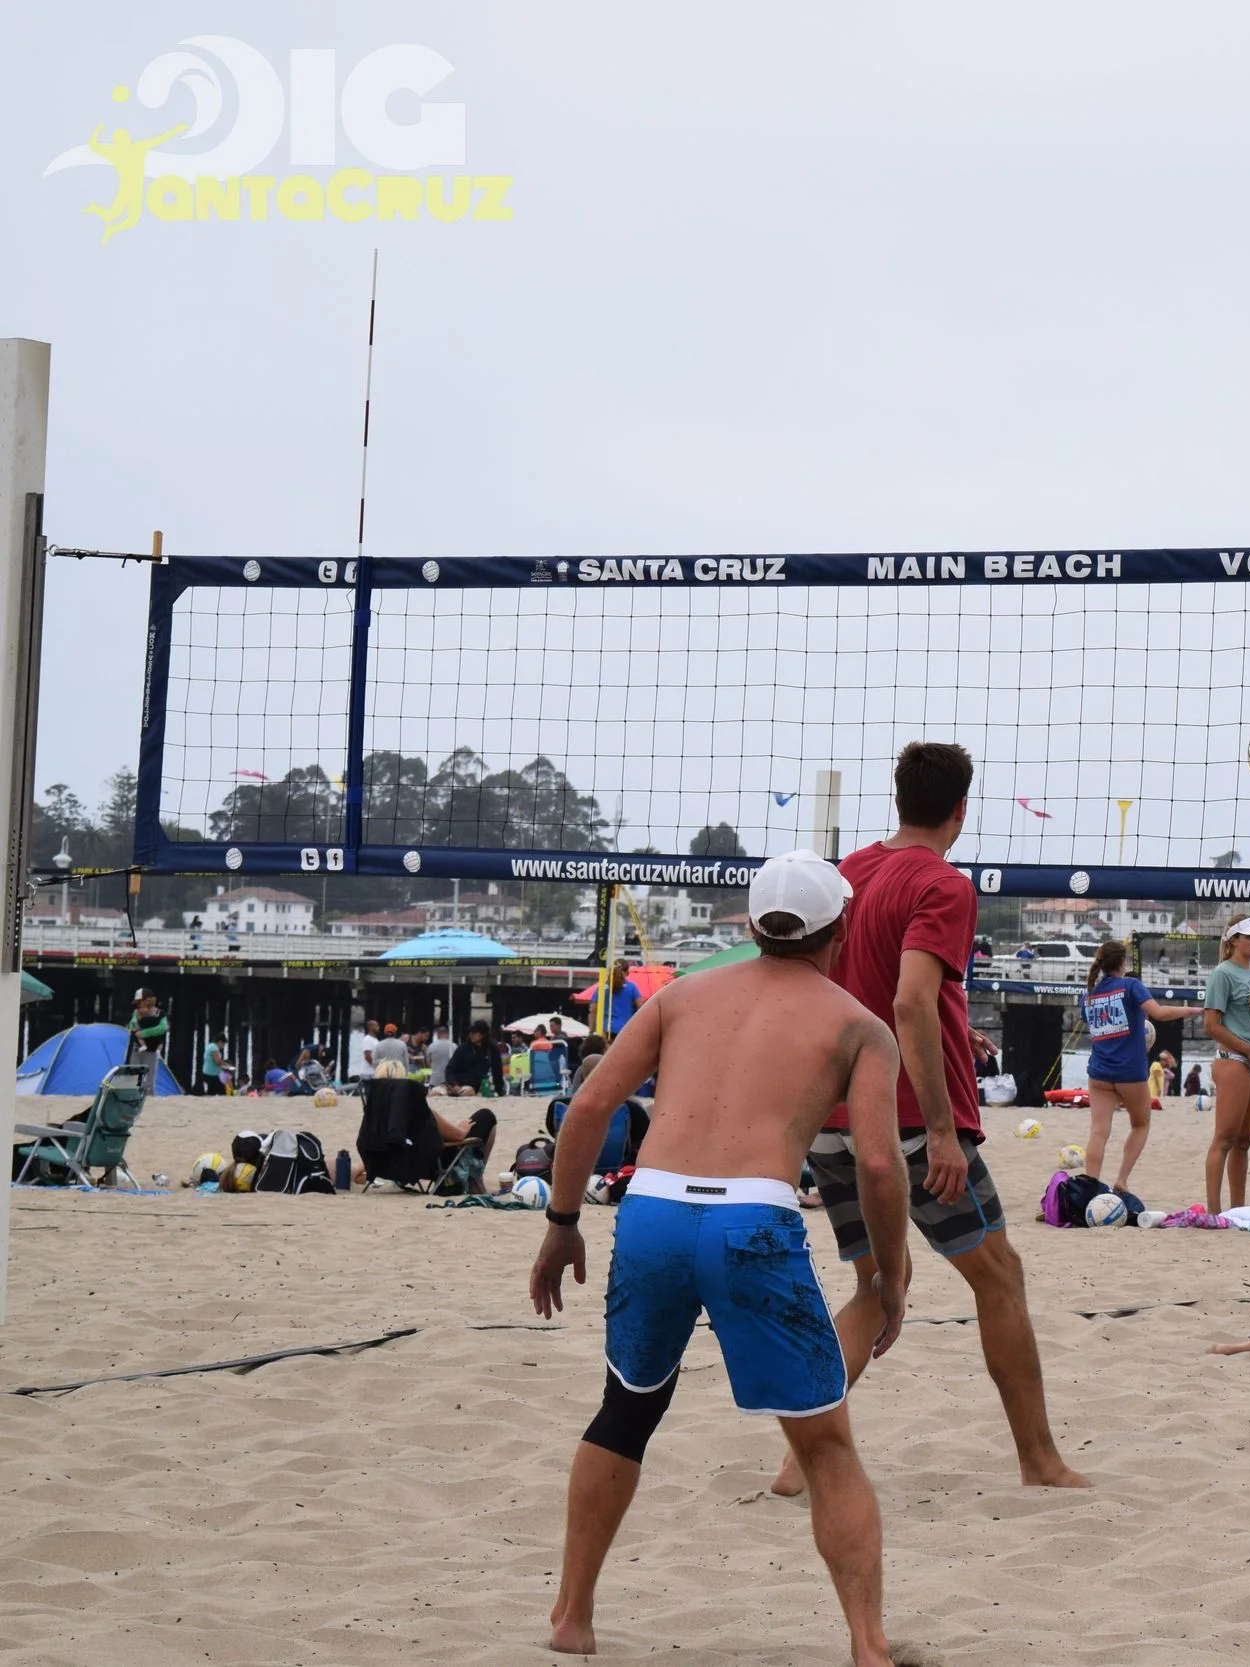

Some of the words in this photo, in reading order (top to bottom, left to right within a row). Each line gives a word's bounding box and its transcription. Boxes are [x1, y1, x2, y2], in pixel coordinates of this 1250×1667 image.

[578, 558, 684, 581] SANTA
[694, 557, 786, 581] CRUZ
[867, 555, 966, 580] MAIN
[984, 553, 1122, 579] BEACH
[1034, 984, 1087, 996] www.santacru
